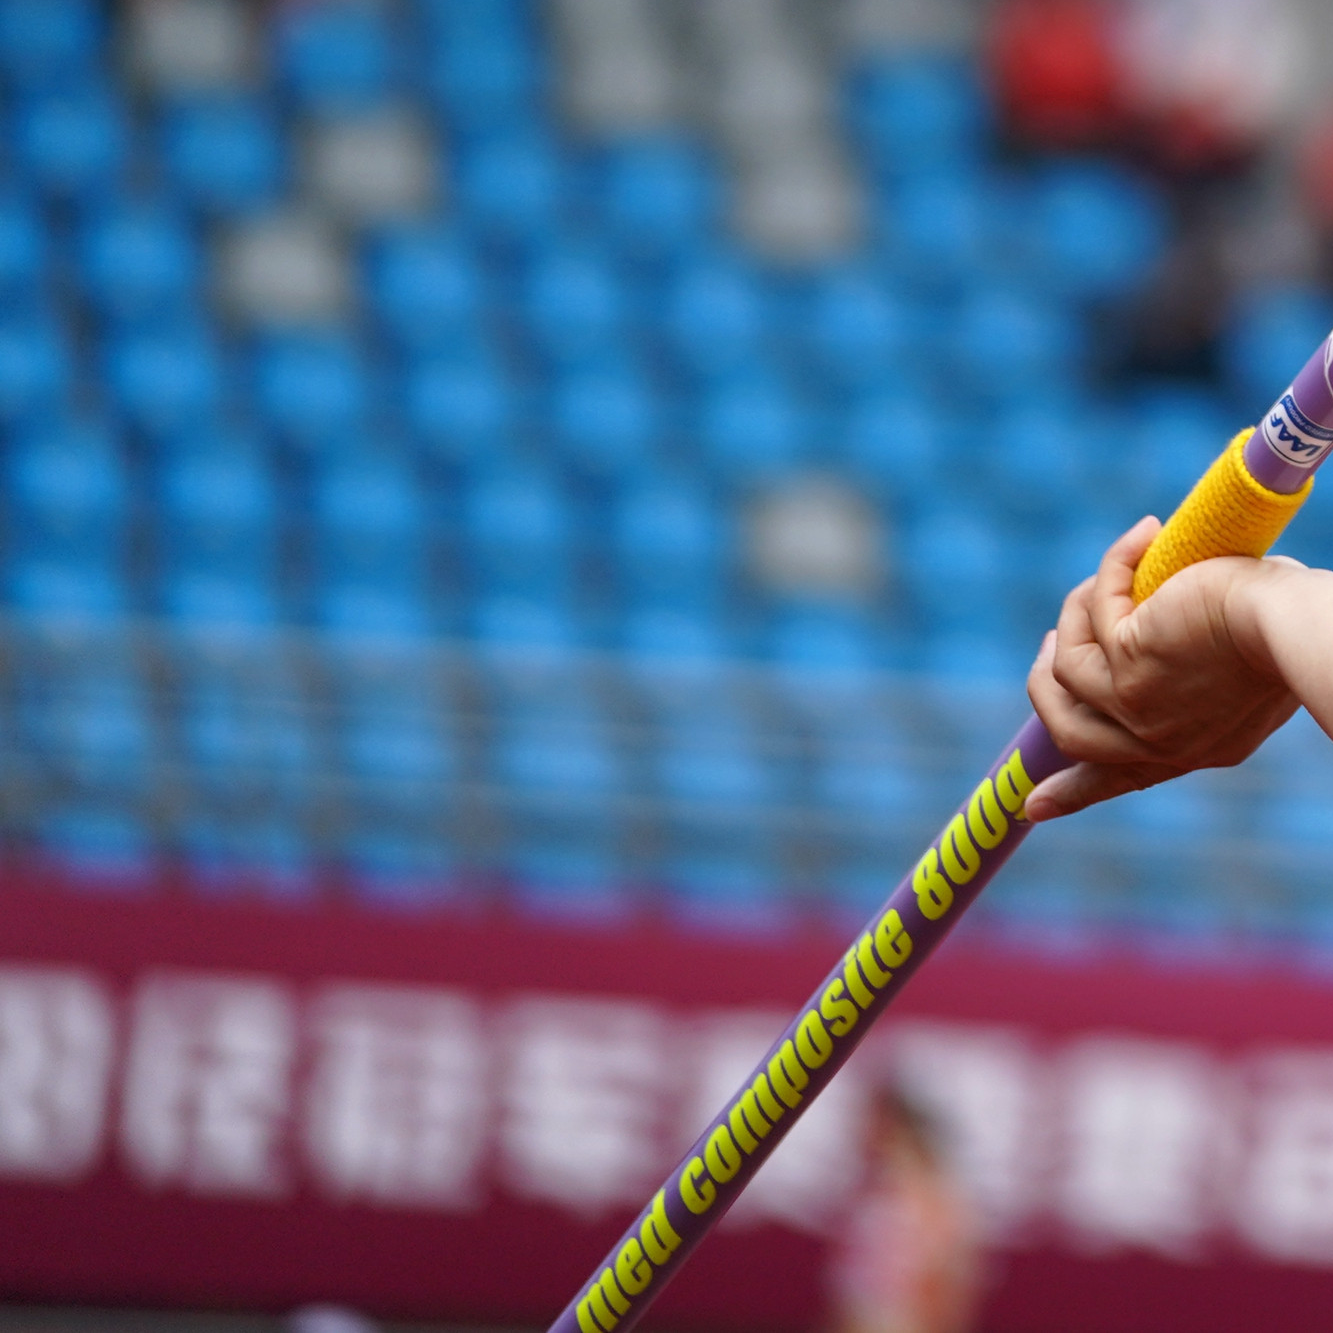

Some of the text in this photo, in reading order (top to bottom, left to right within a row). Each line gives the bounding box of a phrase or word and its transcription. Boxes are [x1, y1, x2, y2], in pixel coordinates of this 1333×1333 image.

[1270, 412, 1322, 457] IAAF
[678, 908, 913, 1215] composite
[911, 747, 1037, 921] 800g
